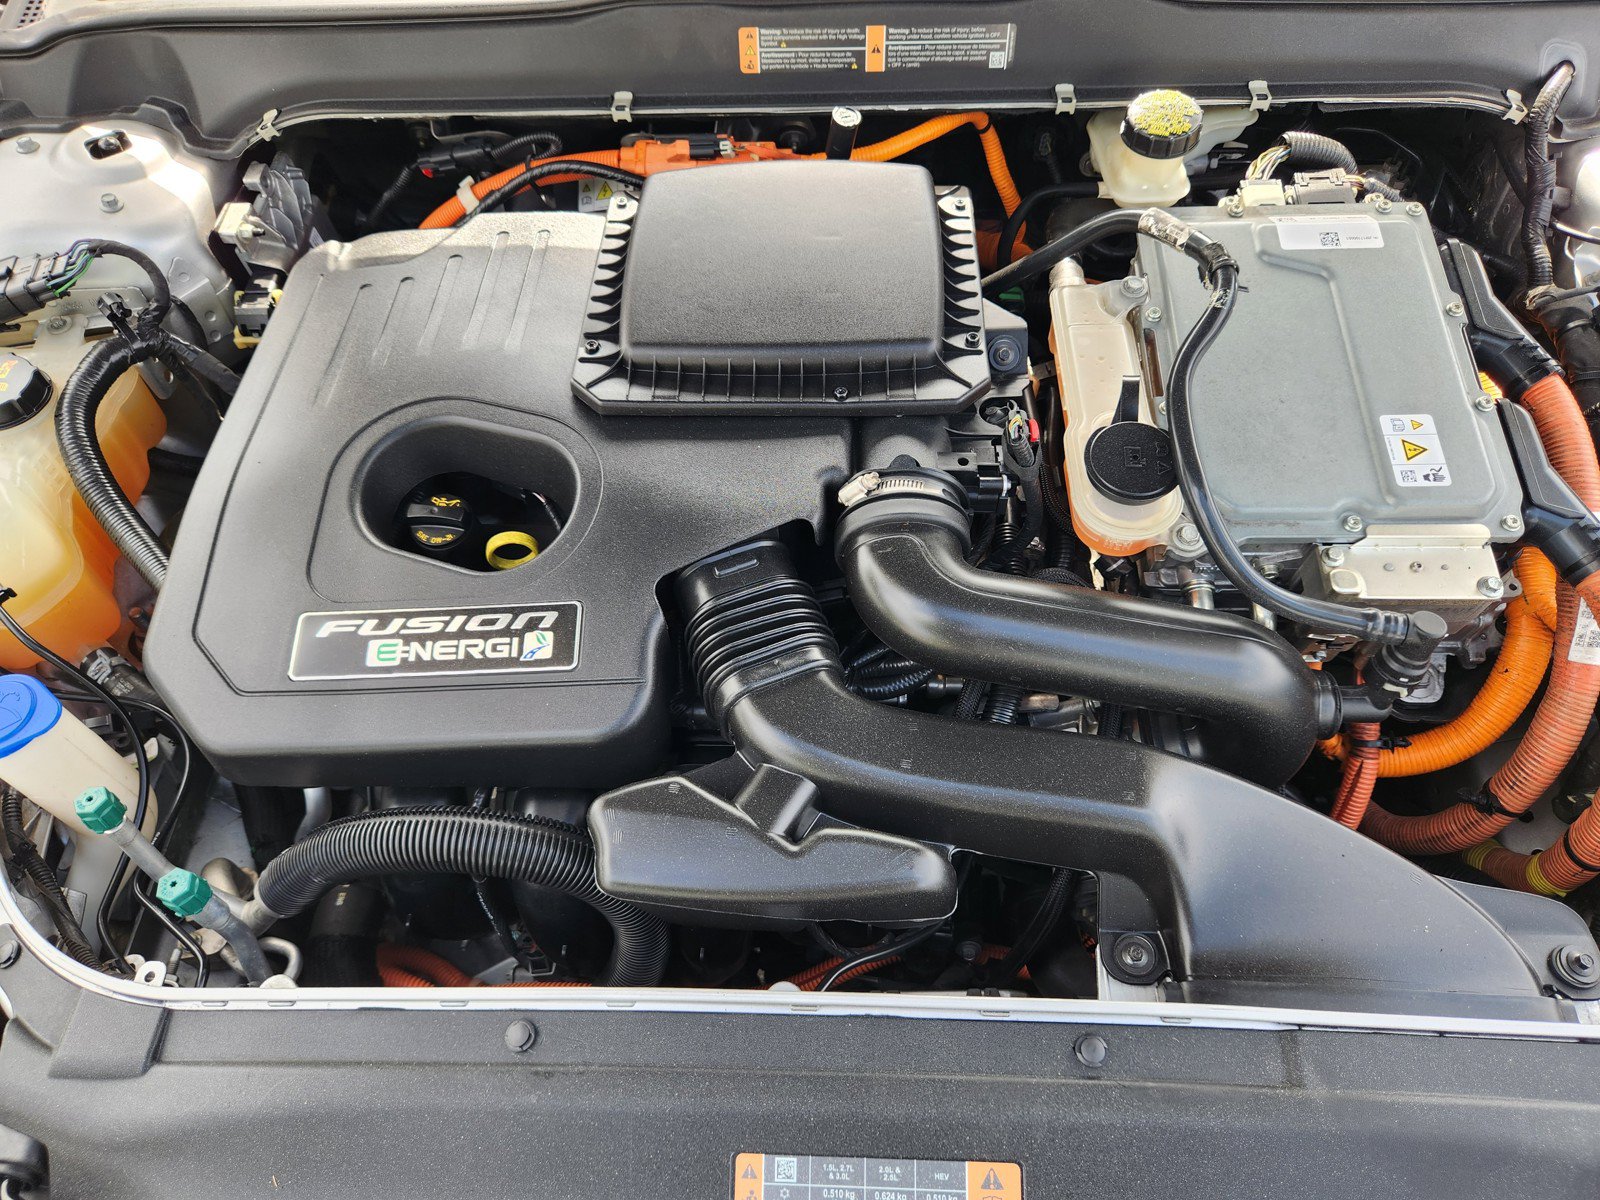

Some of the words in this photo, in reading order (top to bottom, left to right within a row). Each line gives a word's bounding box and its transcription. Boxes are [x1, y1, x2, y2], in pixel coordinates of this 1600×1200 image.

[417, 530, 429, 542] SAE
[315, 611, 559, 638] FUSION
[823, 1188, 844, 1199] 0.510
[845, 1189, 856, 1200] kg
[874, 1191, 895, 1200] 0.624
